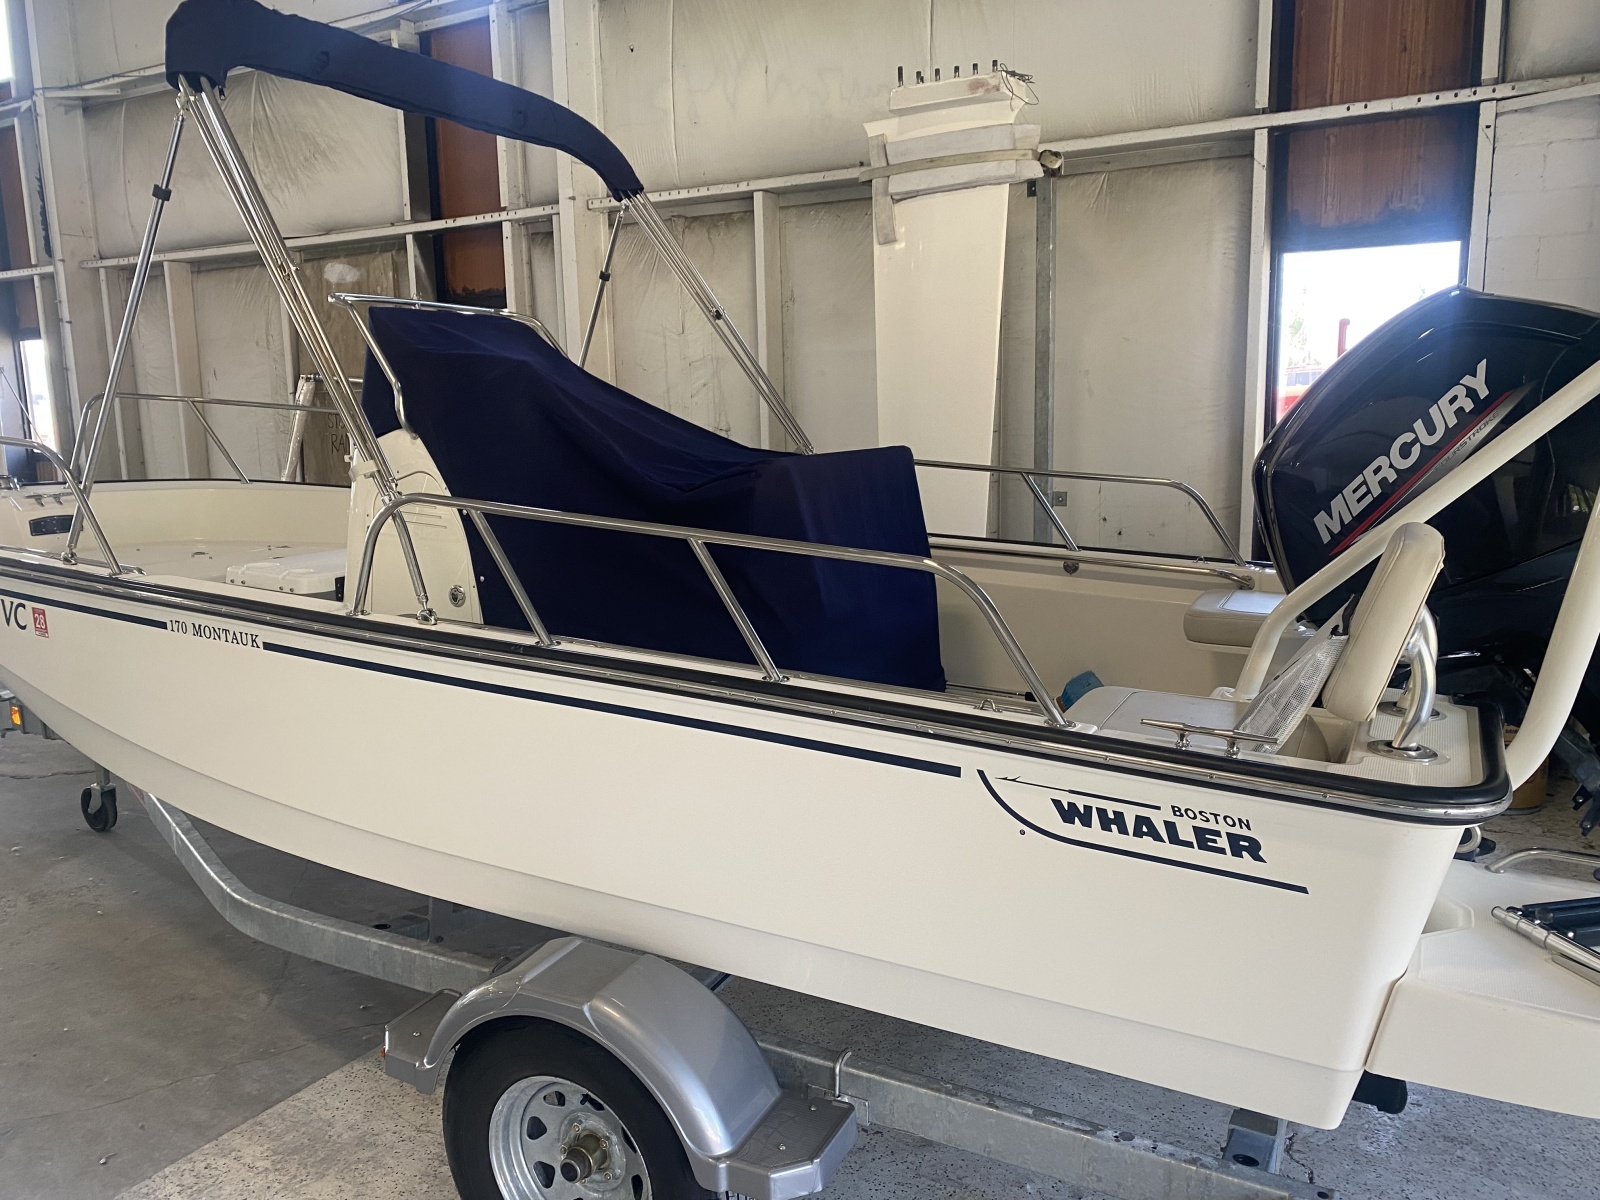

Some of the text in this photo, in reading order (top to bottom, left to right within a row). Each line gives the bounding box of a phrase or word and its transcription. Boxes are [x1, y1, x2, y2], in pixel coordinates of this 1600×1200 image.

[1313, 358, 1490, 545] MERCURY
[1434, 411, 1499, 473] FOURSTROKE
[1, 598, 28, 631] VC
[34, 613, 46, 629] 28
[169, 619, 261, 650] 170 MONTAUK
[1050, 798, 1268, 864] WHALER
[1170, 804, 1252, 832] BOSTON
